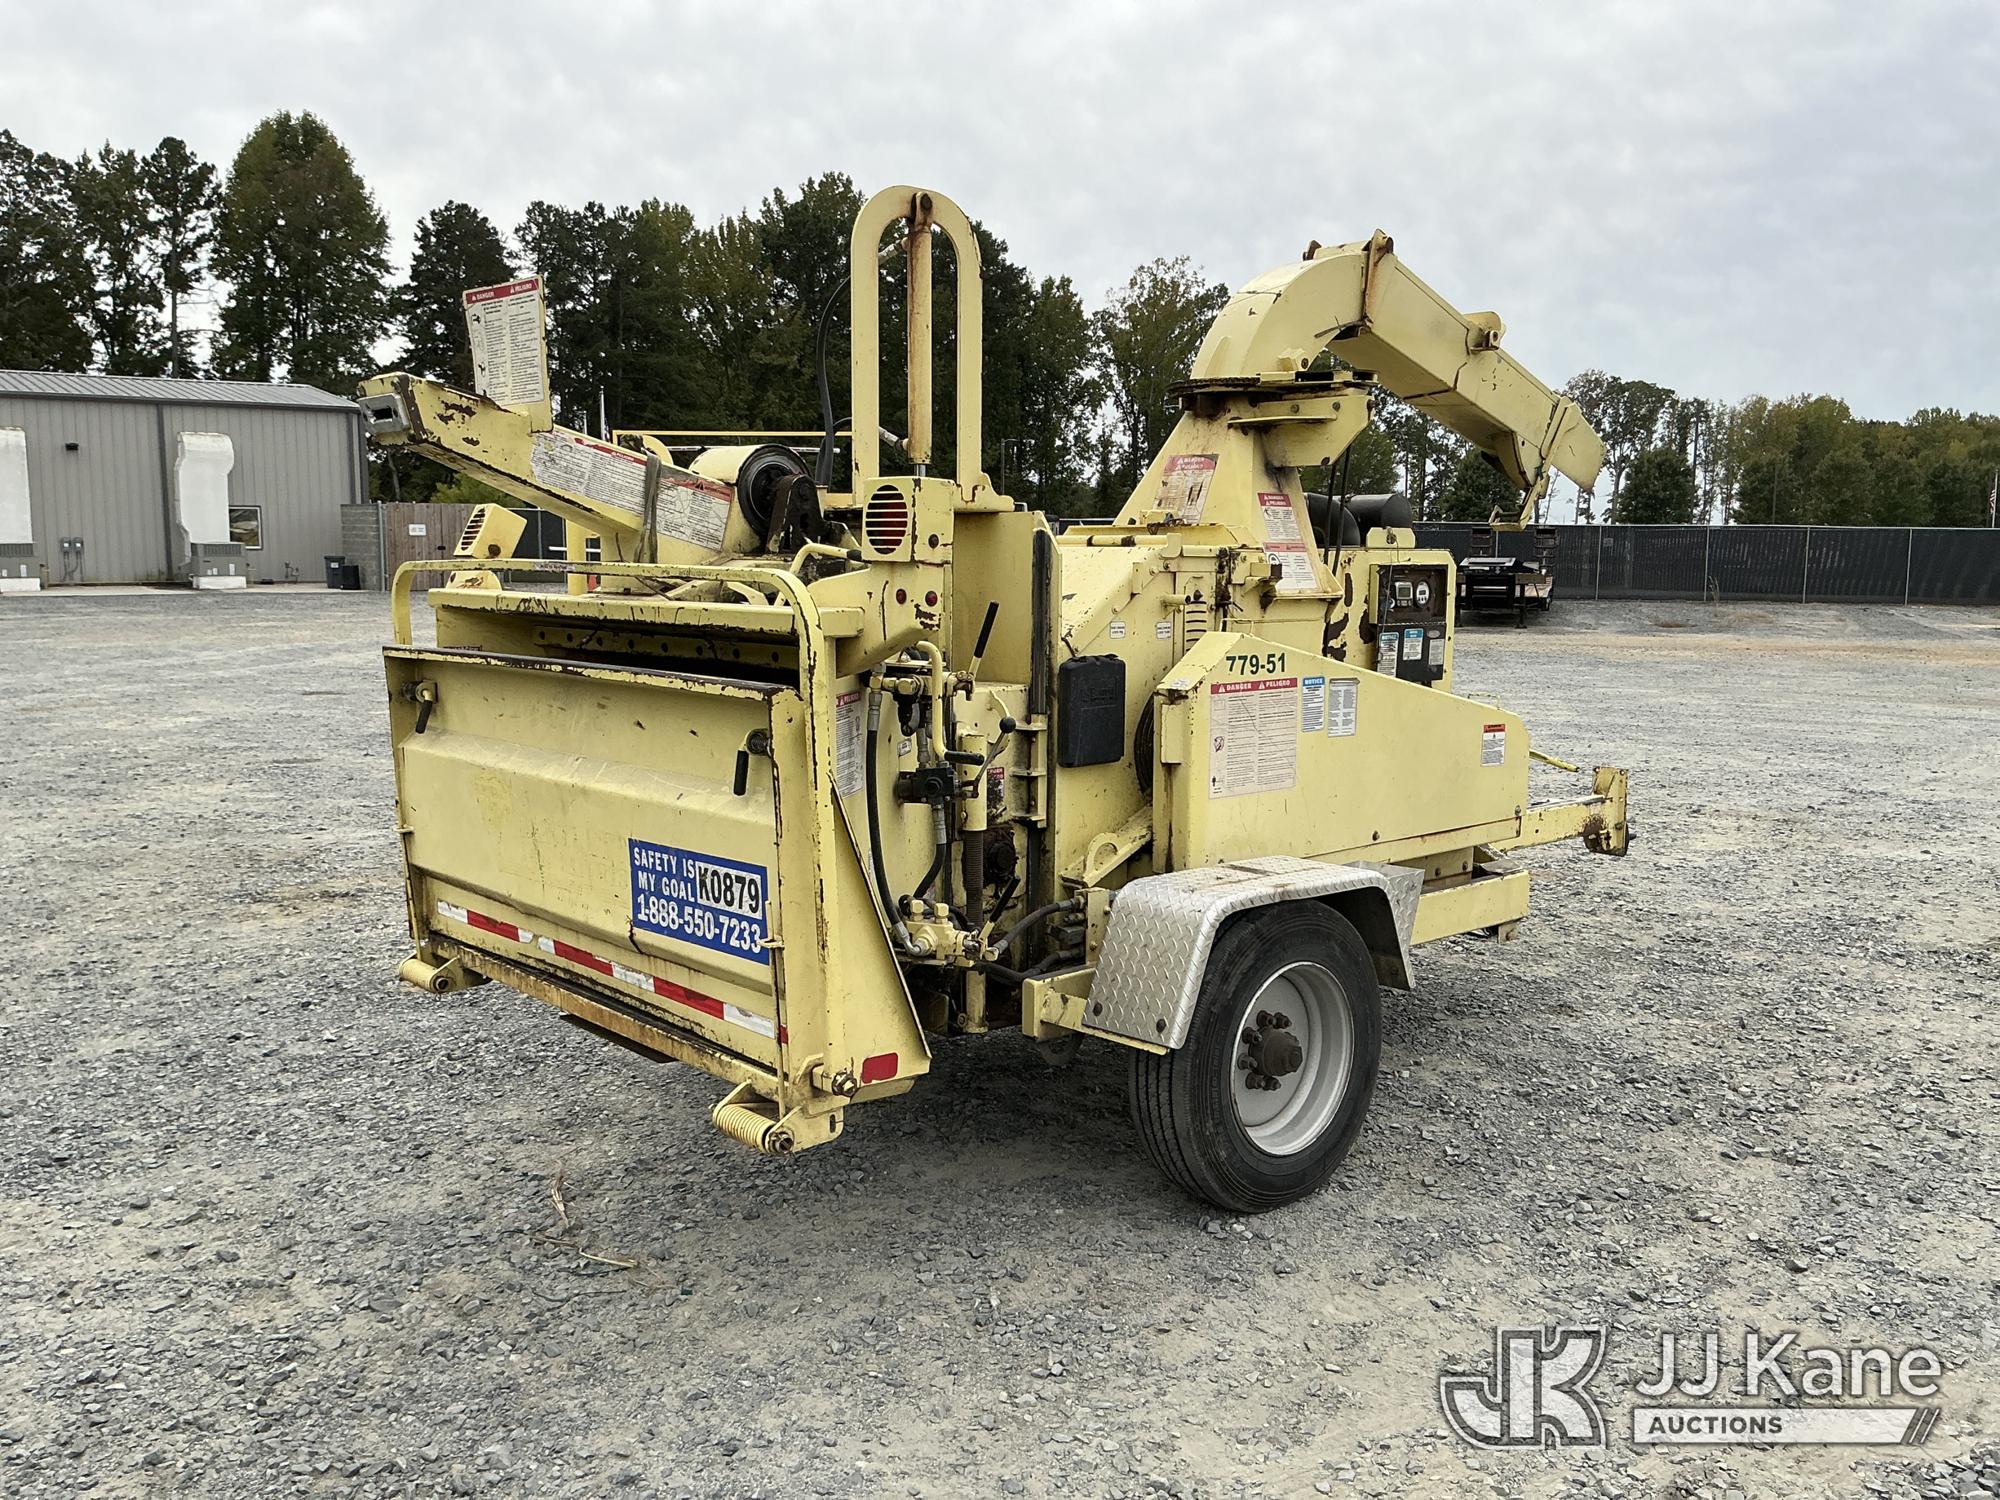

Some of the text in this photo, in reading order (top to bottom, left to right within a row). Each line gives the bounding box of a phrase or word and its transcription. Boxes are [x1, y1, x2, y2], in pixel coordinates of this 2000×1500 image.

[1226, 652, 1285, 675] 779-51
[1226, 680, 1291, 691] DANGER PELIGRO
[634, 847, 696, 879] SAFETY IS
[638, 870, 695, 903] MY GOAL
[698, 866, 760, 914] K0879
[637, 893, 762, 954] 1-888-550-7233
